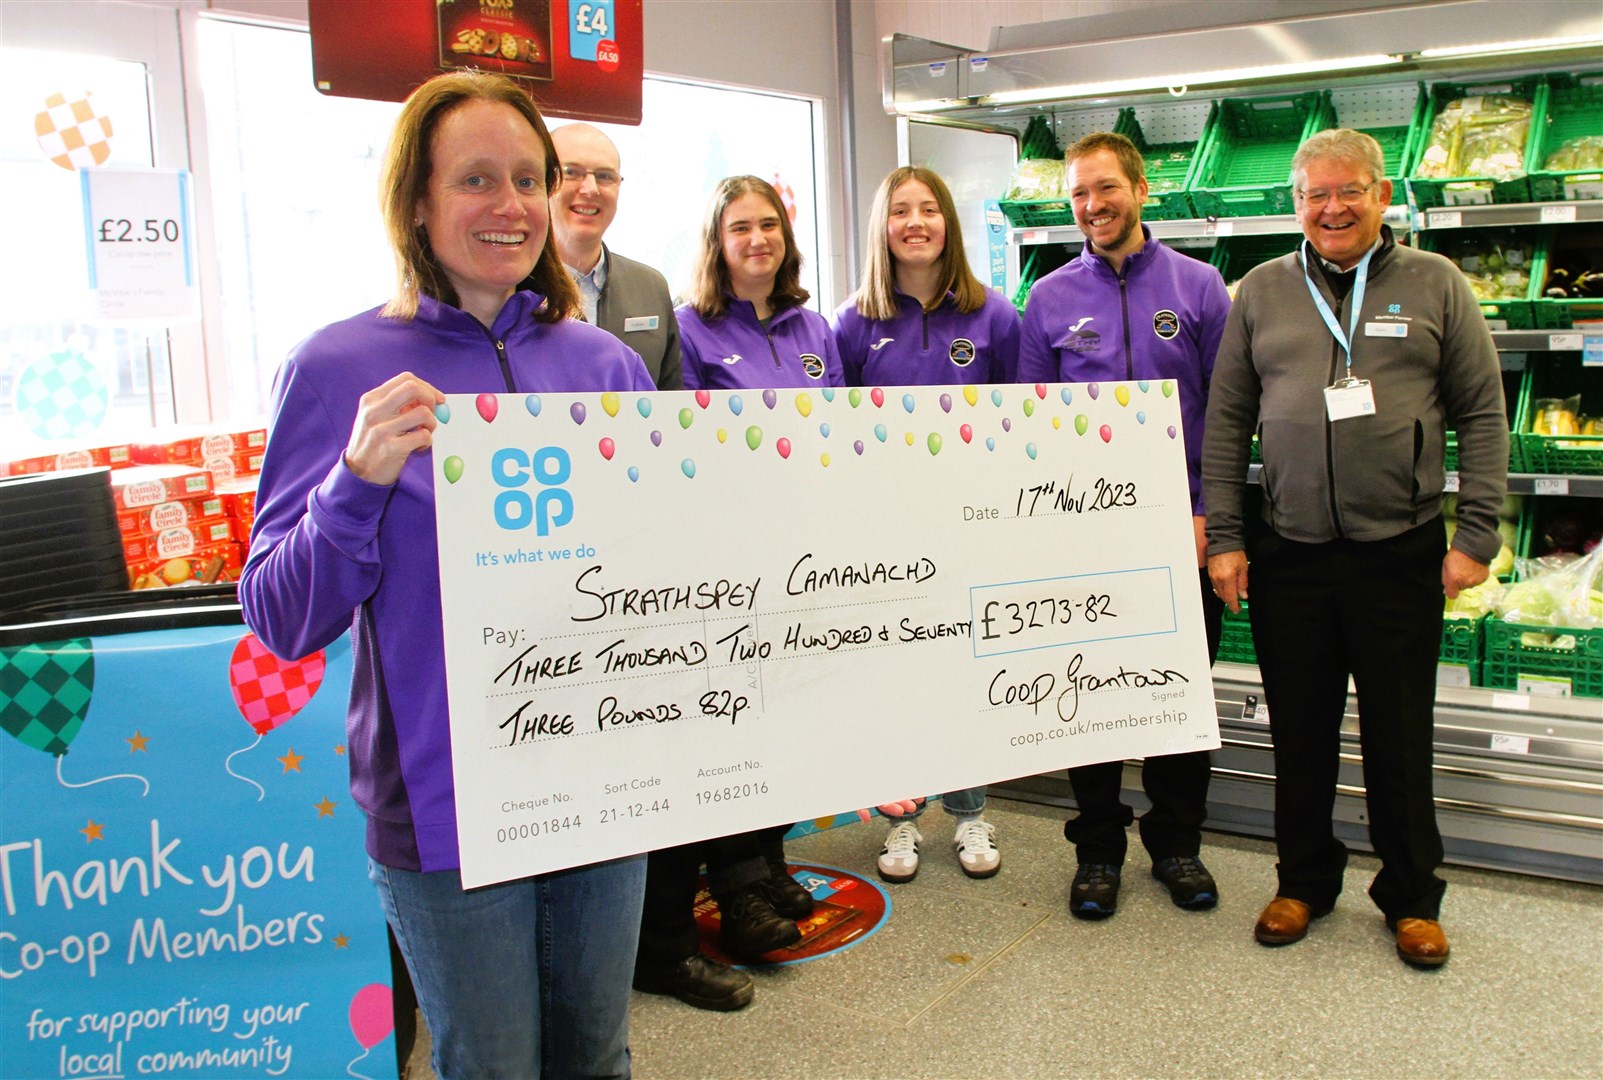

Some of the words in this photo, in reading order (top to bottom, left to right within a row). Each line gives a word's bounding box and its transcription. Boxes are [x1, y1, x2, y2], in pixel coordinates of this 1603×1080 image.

[576, 4, 608, 36] £4
[598, 51, 619, 63] £4.50
[98, 219, 180, 242] £2.50
[1016, 480, 1055, 516] 17th
[1053, 474, 1087, 513] Nov
[1088, 478, 1137, 511] 2023
[963, 506, 999, 521] Date
[476, 551, 499, 566] It's
[503, 549, 543, 564] what
[549, 548, 571, 561] we
[575, 544, 596, 559] do
[571, 565, 761, 621] STRATHSPEY
[787, 553, 936, 596] CAMANACHD
[482, 626, 525, 647] Pay:
[494, 645, 583, 686] THREE
[596, 639, 708, 674] THOUSAND
[1057, 653, 1189, 722] Grantown
[1151, 689, 1185, 702] Signed
[499, 700, 575, 746] THREE
[1010, 710, 1188, 747] coop.co.uk/membership
[697, 763, 740, 779] Account
[742, 758, 763, 771] No.
[604, 780, 629, 795] Sort
[630, 776, 662, 792] Code
[695, 781, 769, 806] 19682016
[501, 796, 549, 814] Cheque
[552, 792, 574, 807] No.
[599, 798, 671, 824] 21-12-44
[497, 814, 582, 844] 00001844
[0, 819, 193, 916] Thank
[199, 842, 314, 917] you
[0, 930, 111, 979] Co-op
[127, 904, 325, 964] Members
[26, 1008, 72, 1041] for
[77, 998, 229, 1043] supporting
[233, 1002, 310, 1039] your
[59, 1041, 124, 1078] local
[137, 1035, 292, 1075] community
